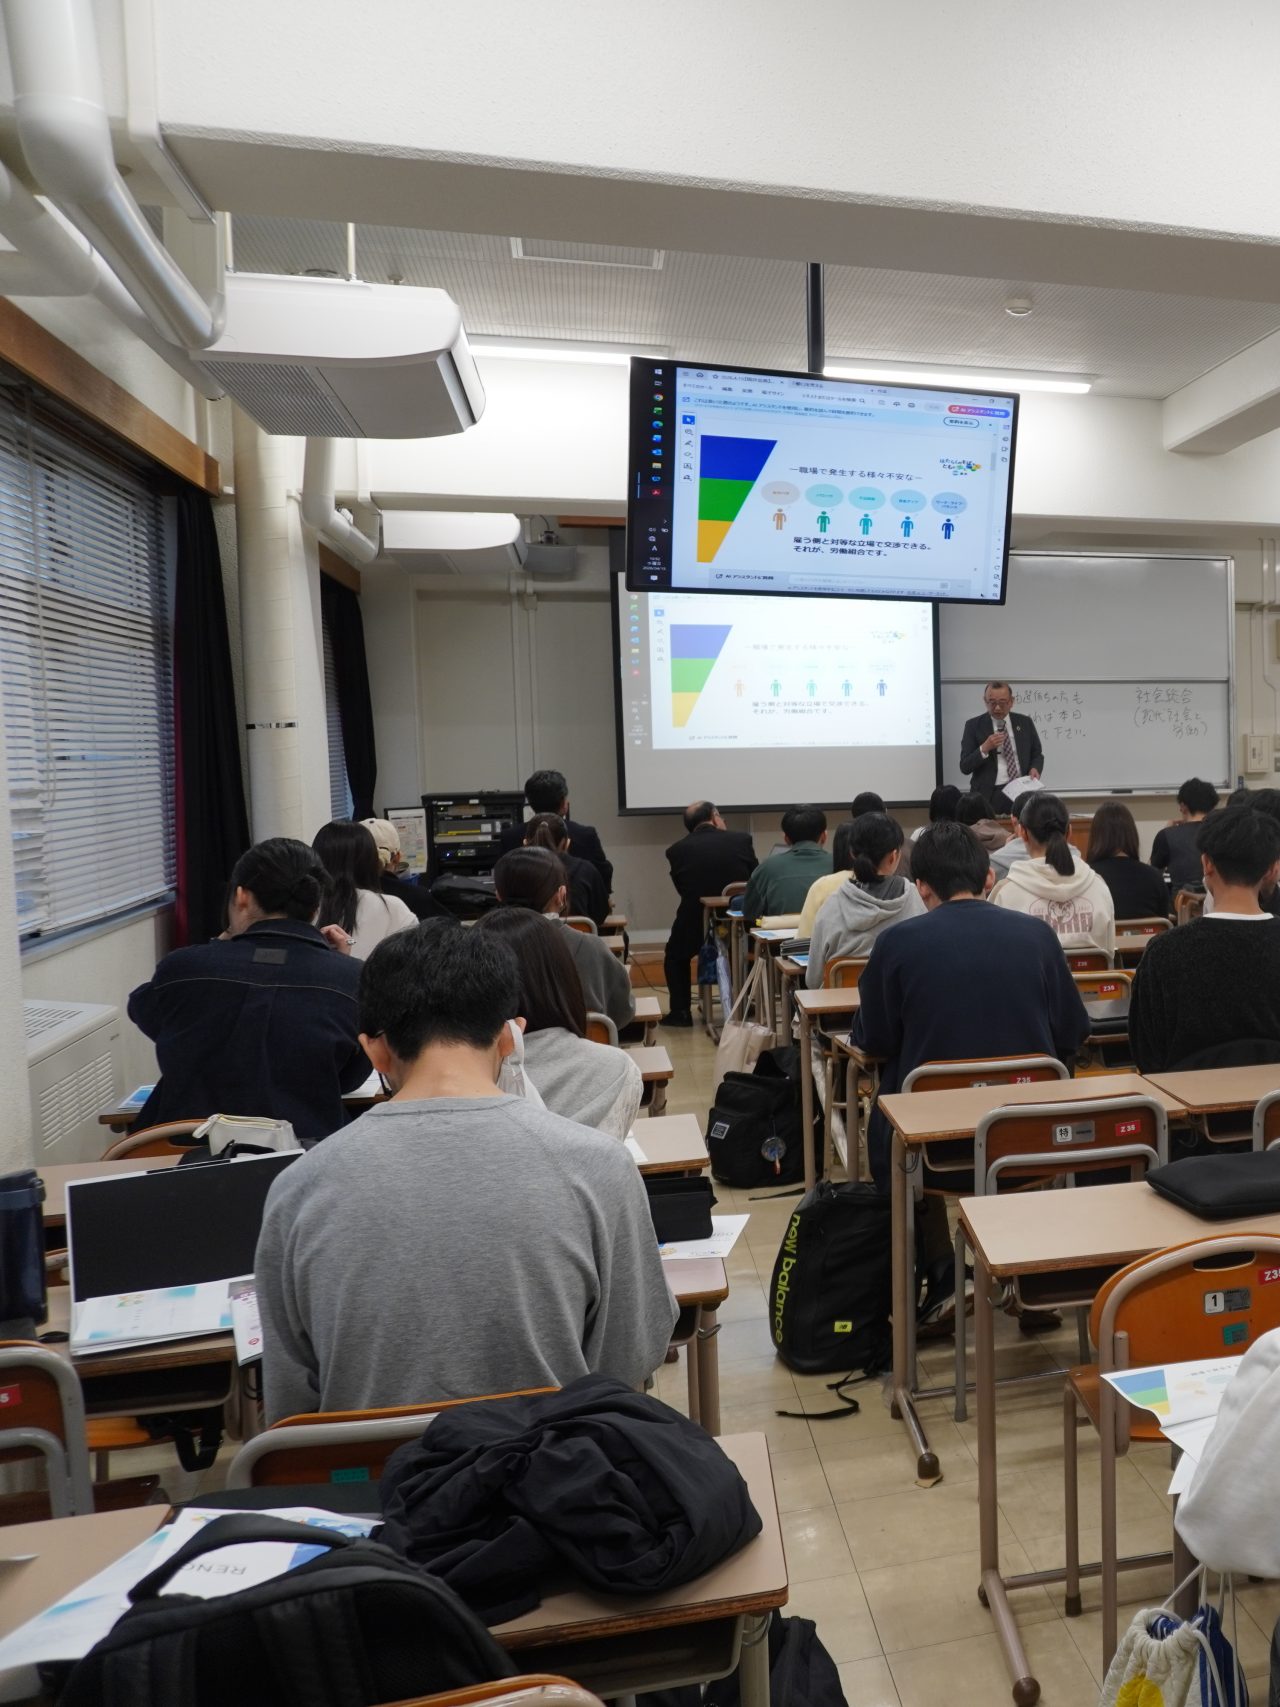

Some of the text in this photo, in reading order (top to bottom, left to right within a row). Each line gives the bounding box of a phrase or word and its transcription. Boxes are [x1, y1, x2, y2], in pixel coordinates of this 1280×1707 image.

[1059, 1127, 1069, 1138] 特
[775, 1213, 800, 1343] new balance
[1211, 1294, 1218, 1307] 1
